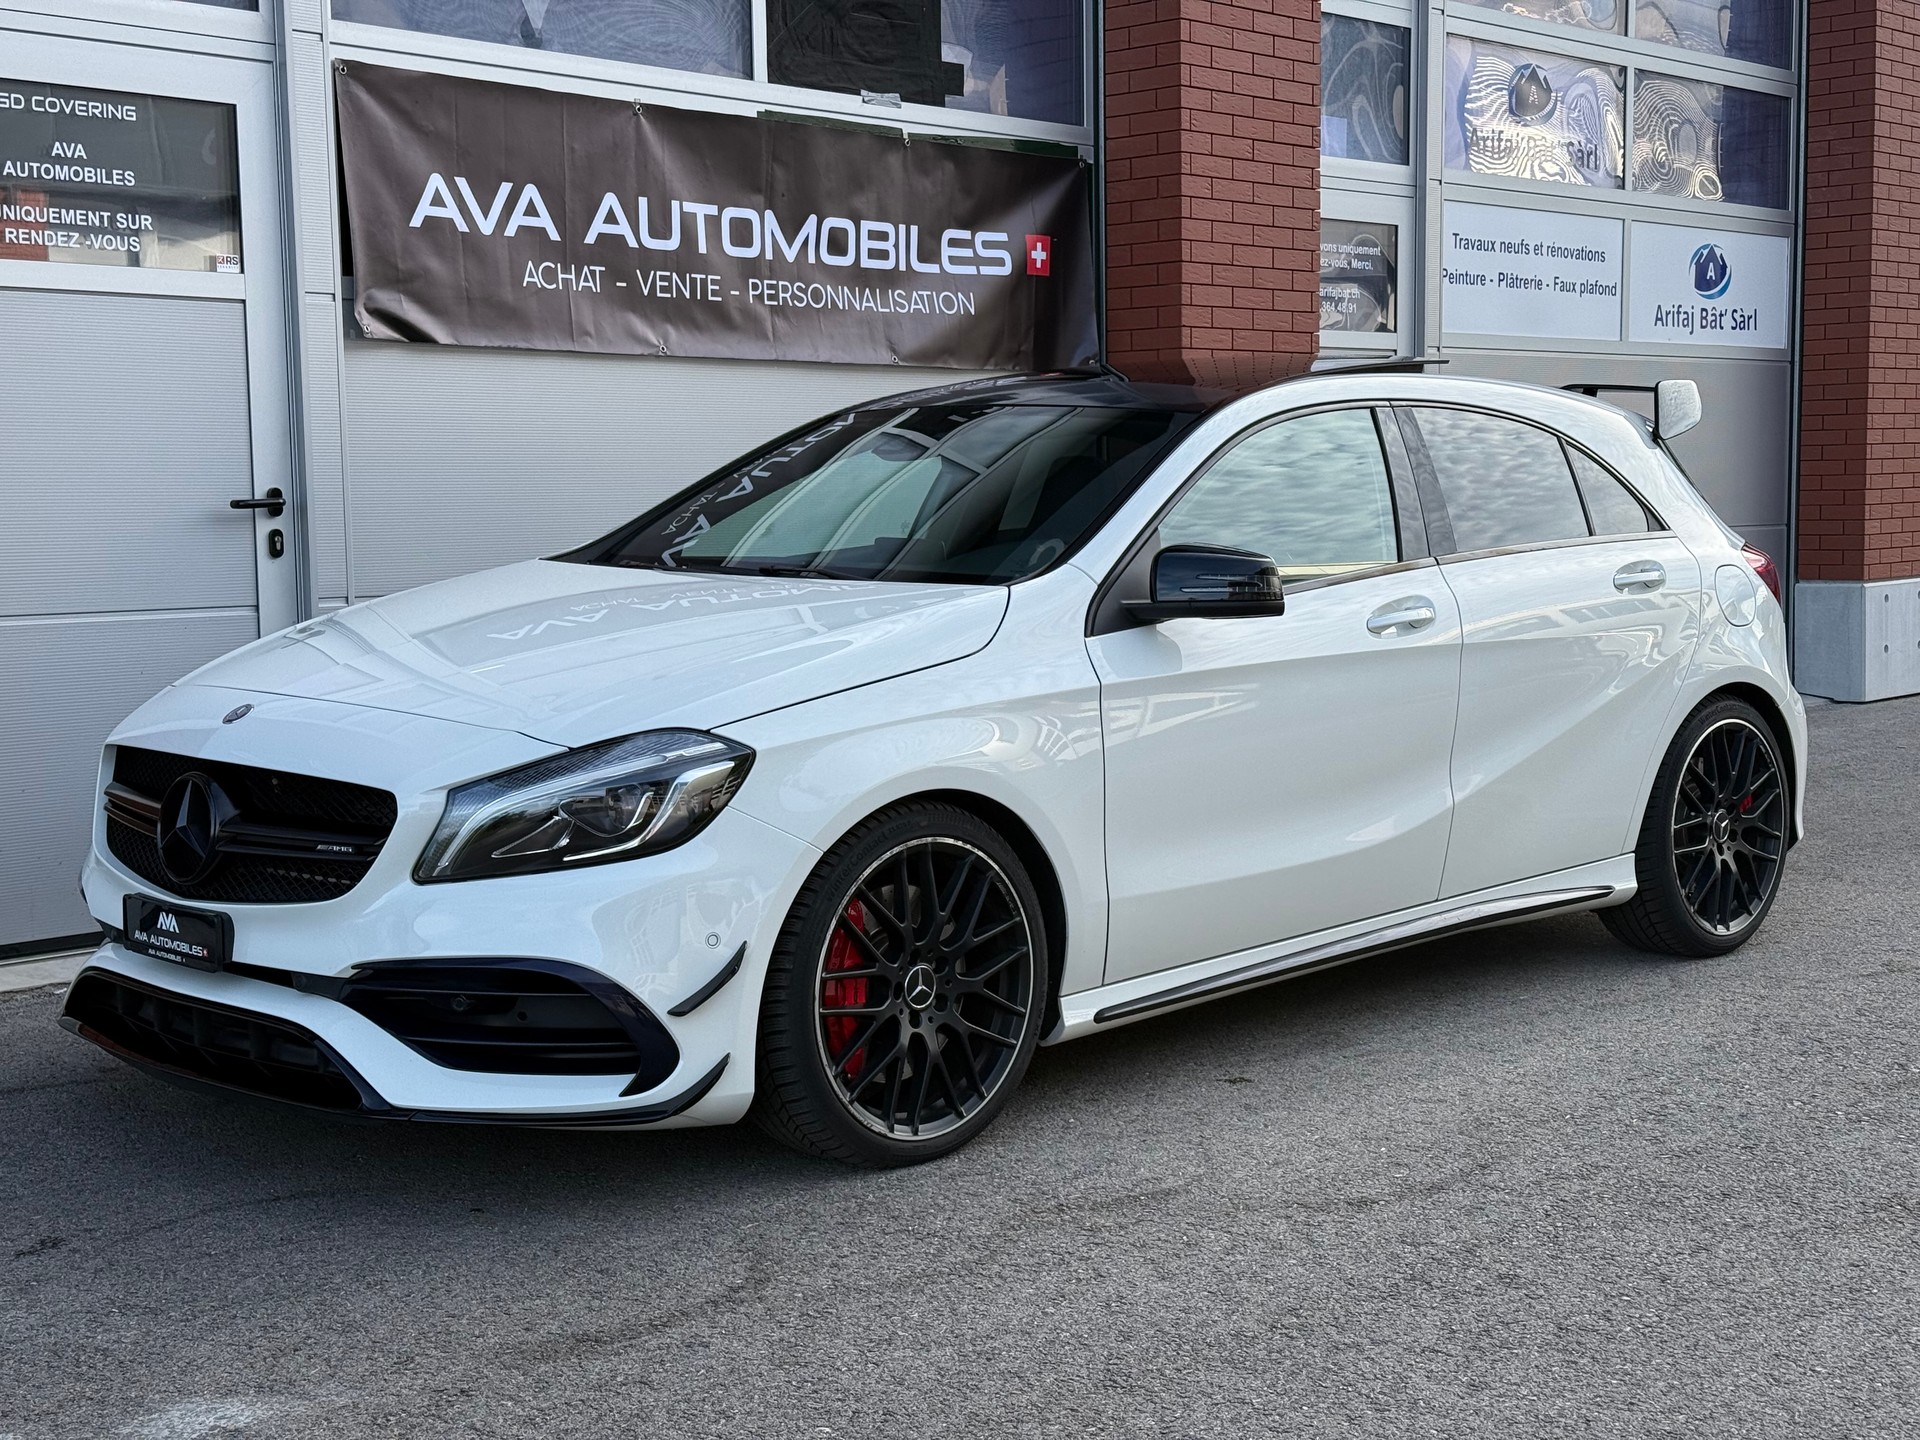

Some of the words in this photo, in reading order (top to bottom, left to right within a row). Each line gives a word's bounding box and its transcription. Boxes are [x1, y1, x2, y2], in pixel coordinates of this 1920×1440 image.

[31, 96, 137, 121] COVERING
[51, 141, 87, 159] AVA
[3, 160, 136, 186] AUTOMOBILES
[0, 204, 110, 227] NIQUEMENT
[116, 212, 153, 230] SUR
[409, 172, 562, 242] AVA
[583, 191, 1013, 276] AUTOMOBILES
[5, 227, 80, 248] RENDEZ
[1338, 243, 1381, 256] uniquement
[1452, 232, 1496, 252] Travaux
[1499, 239, 1530, 256] neufs
[1533, 241, 1544, 257] et
[1546, 242, 1606, 263] rénovations
[1351, 258, 1374, 270] Merci.
[1706, 262, 1716, 280] A
[523, 260, 606, 293] ACHAT
[636, 268, 723, 301] VENTE
[748, 278, 975, 315] PERSONNALISATION
[1442, 268, 1487, 286] Peinture
[1498, 272, 1543, 291] Plâtrerie
[1553, 276, 1577, 293] Faux
[1579, 279, 1617, 298] plafond
[1654, 304, 1695, 335] Arifaj
[1731, 308, 1758, 331] Sàrl
[157, 911, 180, 934] AVA
[134, 929, 149, 942] AVA
[150, 934, 203, 957] AUTOMOBILES
